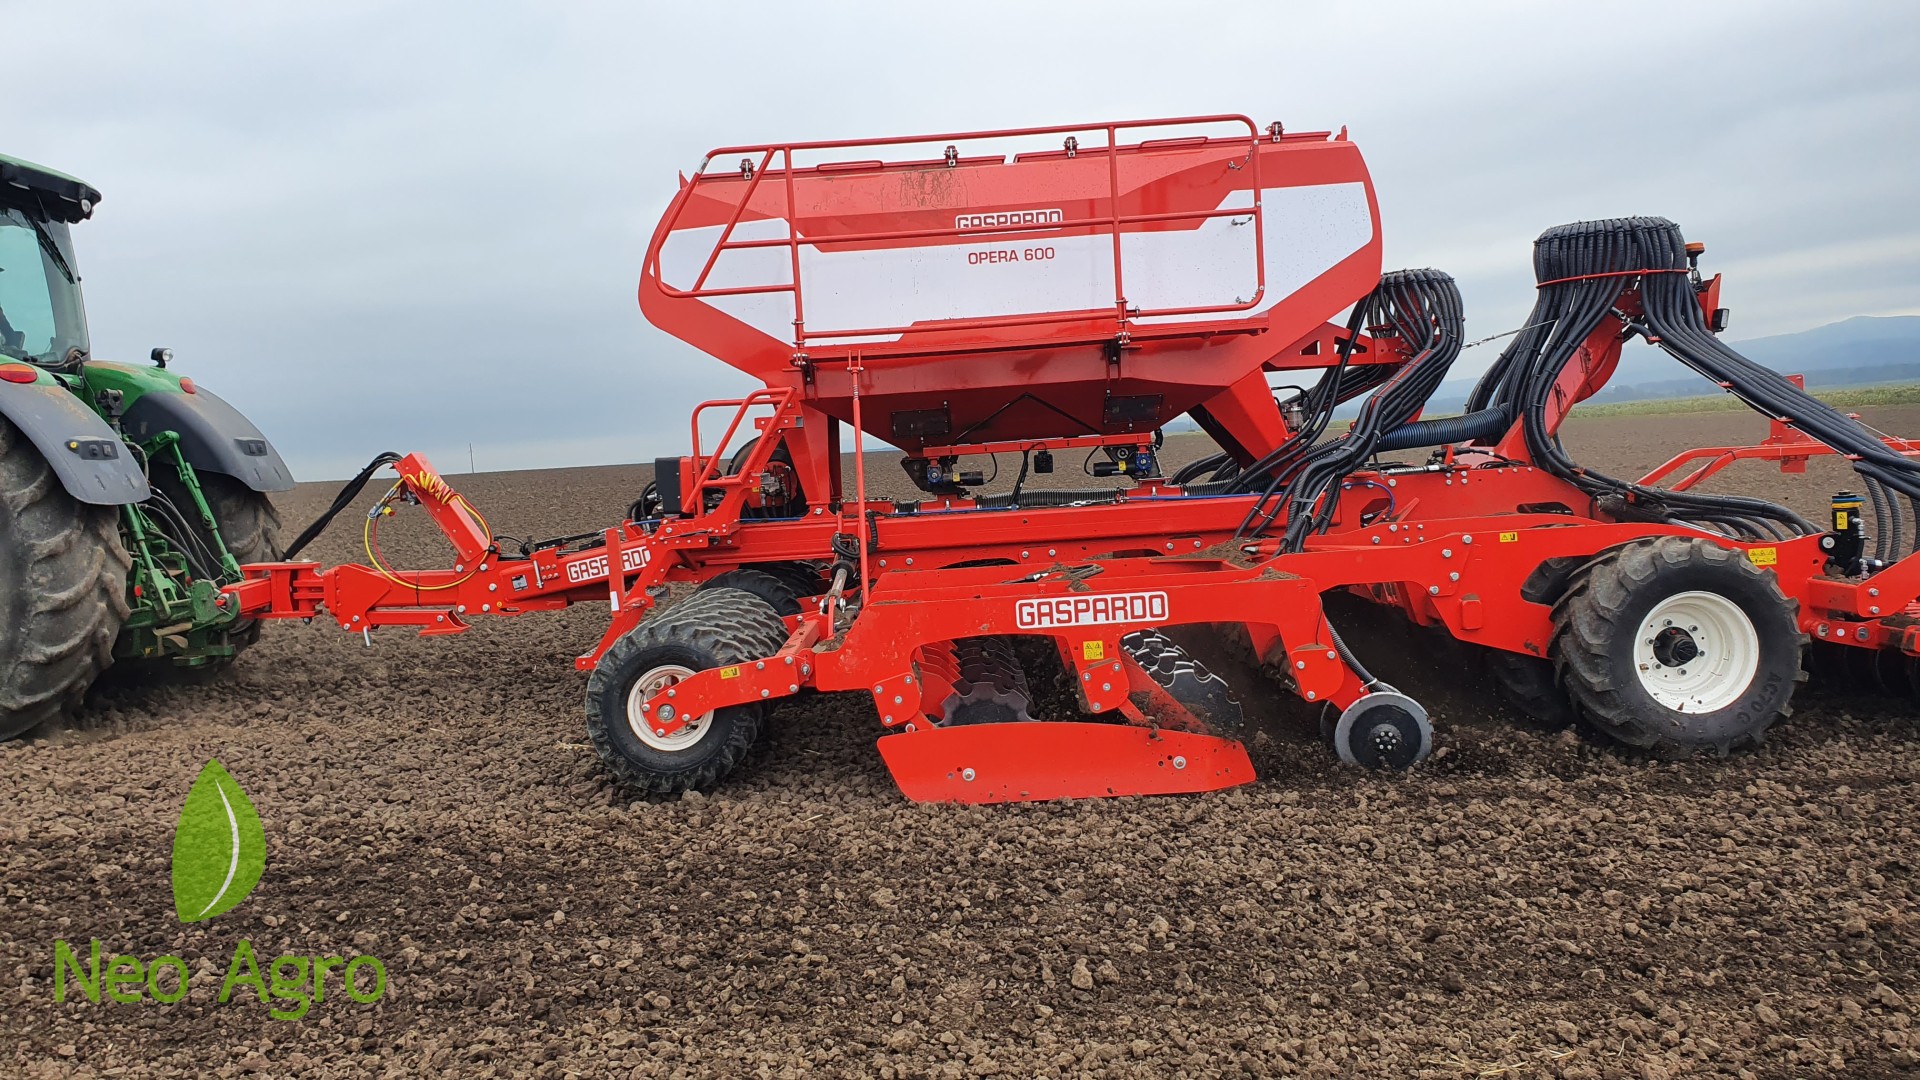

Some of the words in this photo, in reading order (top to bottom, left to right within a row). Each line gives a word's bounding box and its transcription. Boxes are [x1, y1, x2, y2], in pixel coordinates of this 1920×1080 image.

[968, 249, 1019, 265] OPERA
[1024, 247, 1055, 262] 600
[568, 548, 651, 581] GASPRDO
[1018, 594, 1166, 627] GASPARDO
